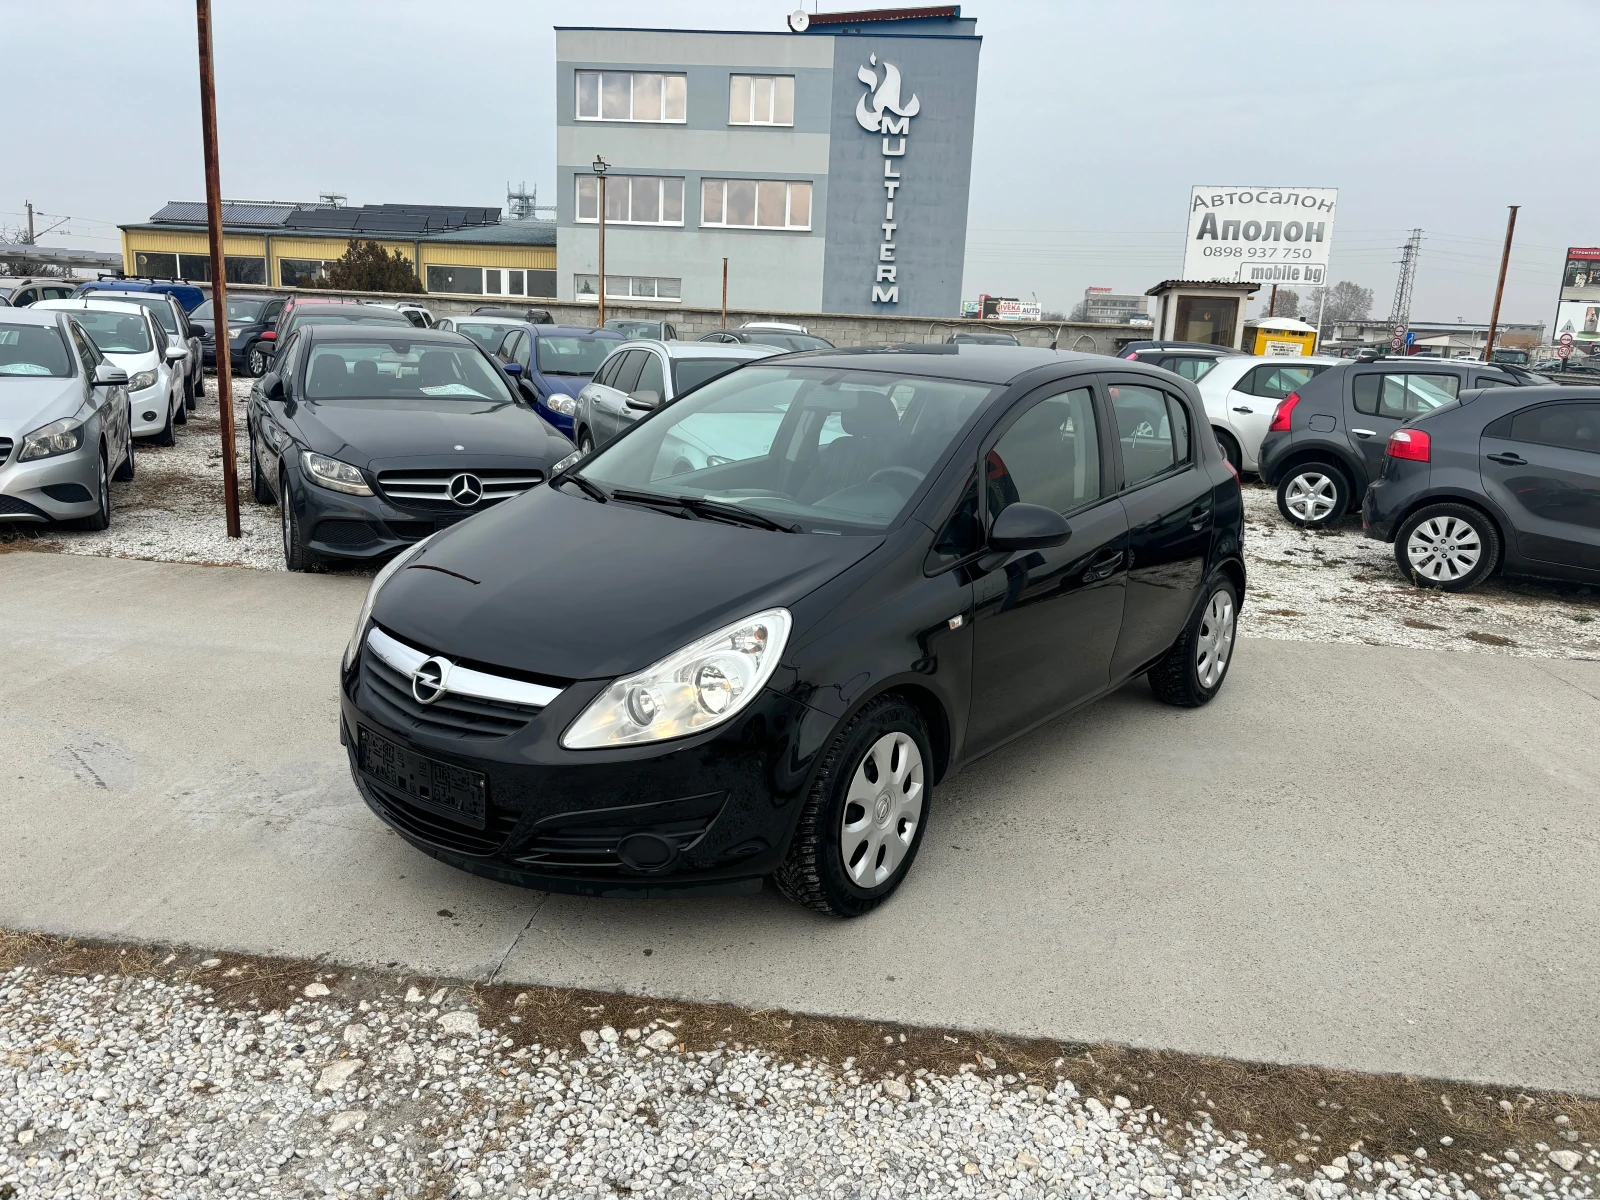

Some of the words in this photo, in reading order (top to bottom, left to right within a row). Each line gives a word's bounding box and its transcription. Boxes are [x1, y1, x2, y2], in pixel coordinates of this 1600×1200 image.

[872, 116, 909, 303] MULTITERM
[1192, 191, 1335, 213] Автосалон
[1196, 212, 1326, 243] Аполон
[1203, 246, 1243, 258] 0898
[1247, 247, 1278, 259] 937
[1282, 248, 1312, 259] 750
[1250, 264, 1301, 281] mobile
[1303, 265, 1322, 283] bg
[1560, 348, 1568, 356] 50
